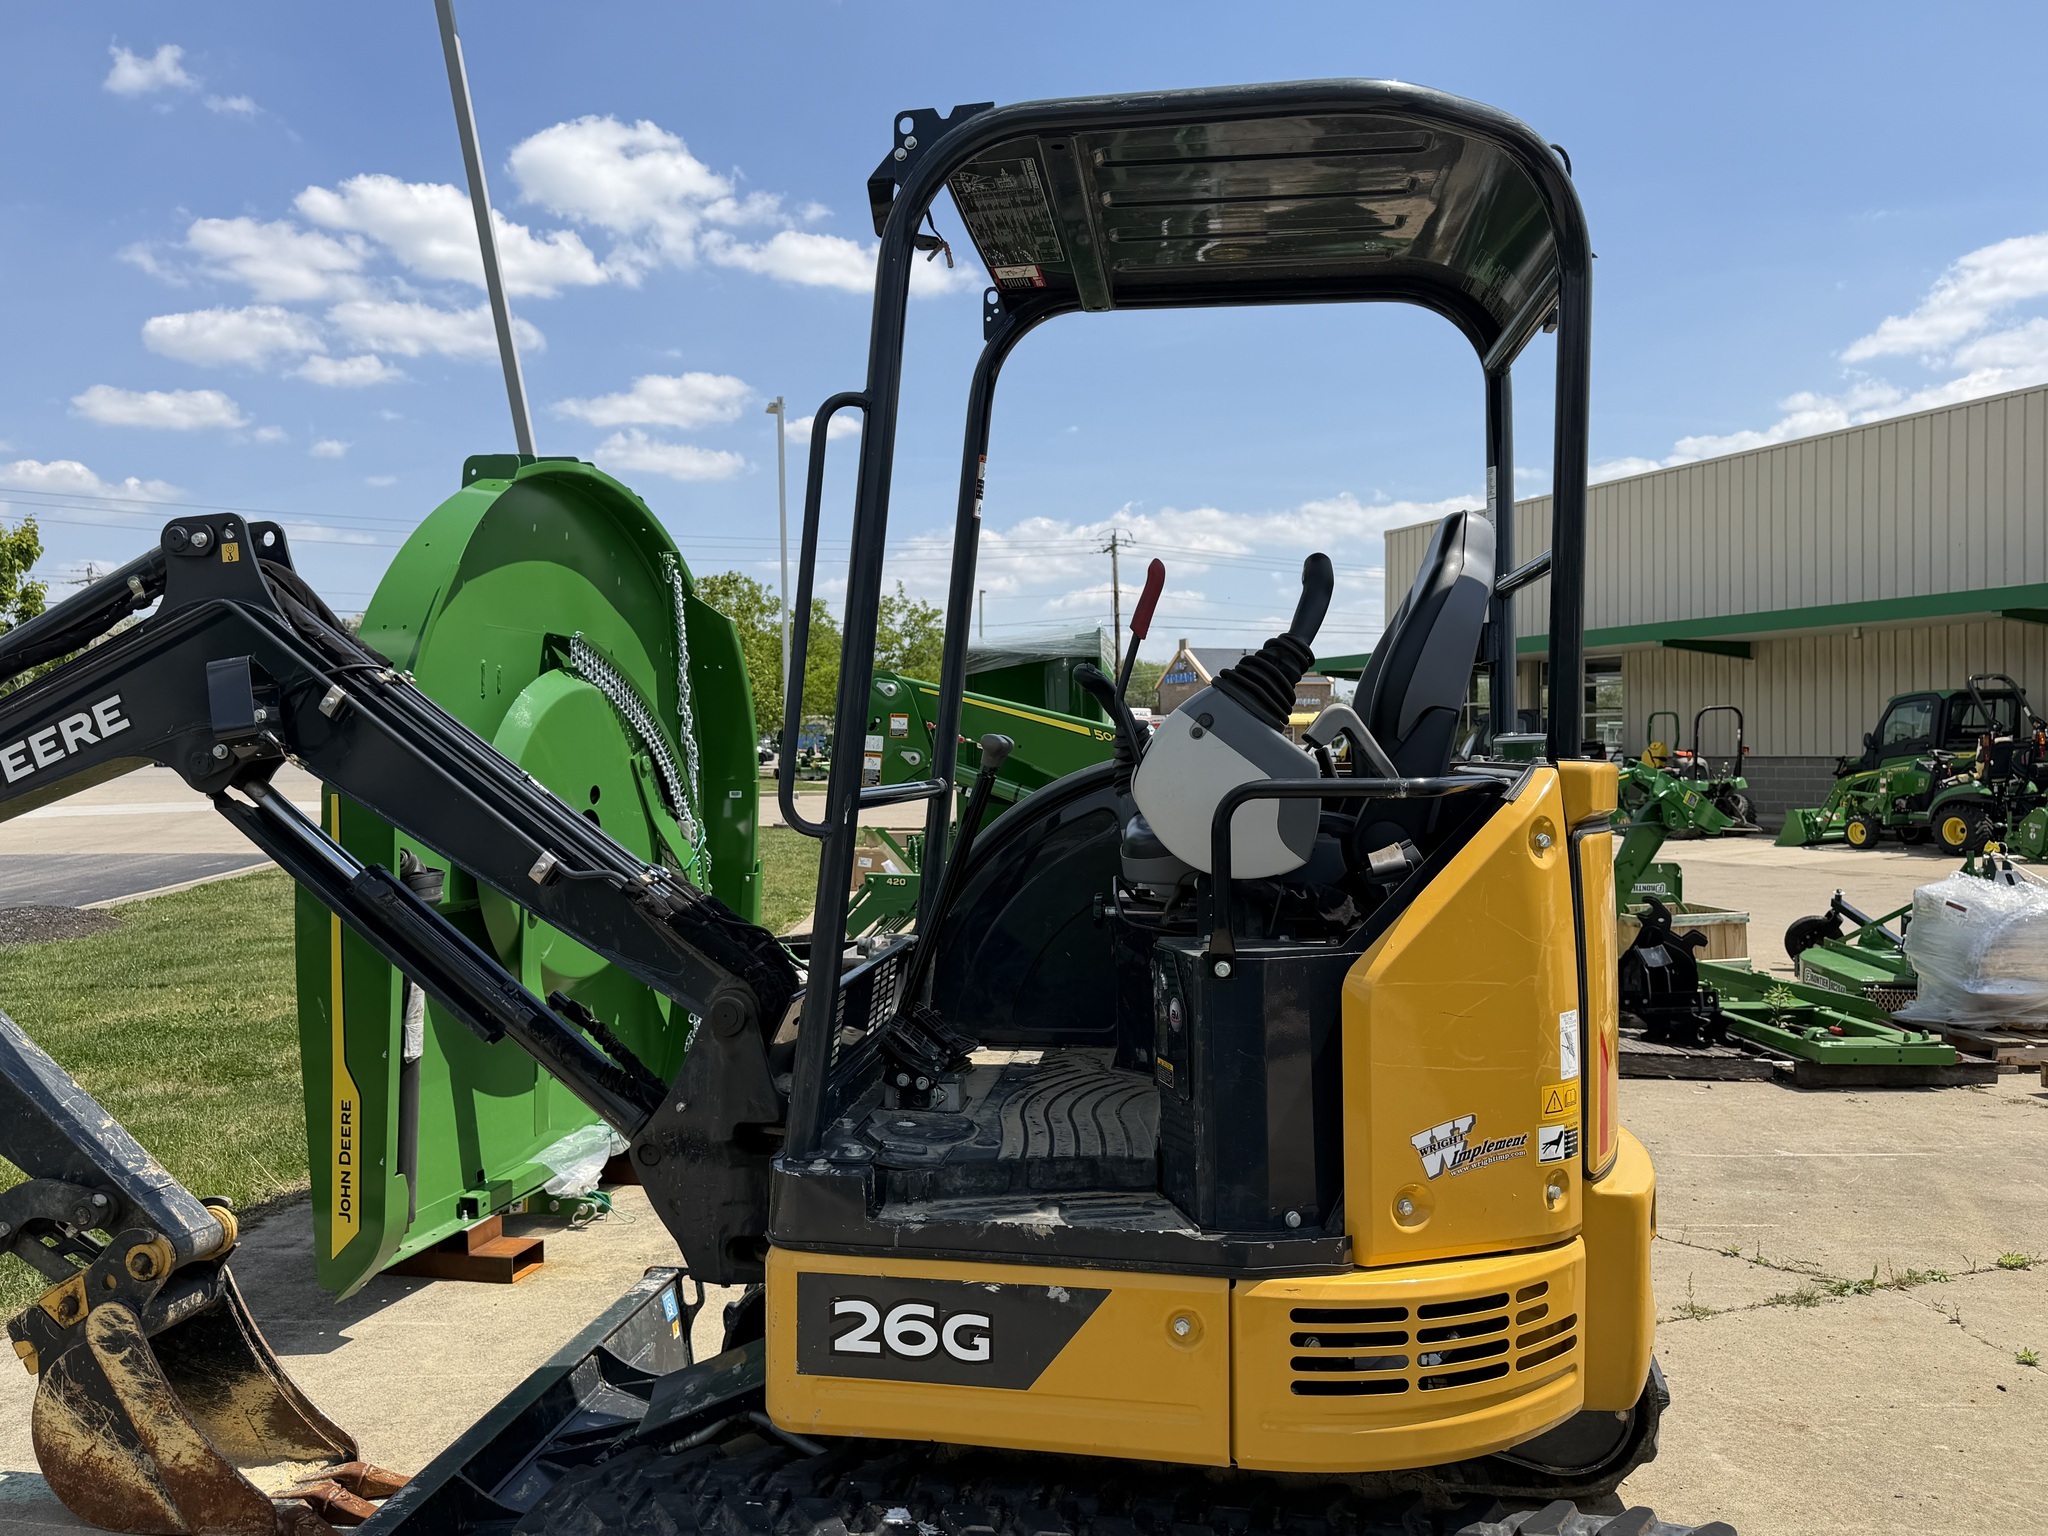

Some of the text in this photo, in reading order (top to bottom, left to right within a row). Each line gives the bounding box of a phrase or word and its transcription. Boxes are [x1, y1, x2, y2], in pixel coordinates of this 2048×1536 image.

[886, 877, 907, 886] 420
[1419, 1133, 1466, 1157] WRIGHT
[1450, 1133, 1528, 1167] Implement
[338, 1099, 352, 1223] JOHN DEERE
[1450, 1150, 1526, 1177] www.wrightimp.com
[834, 1300, 990, 1362] 26G
